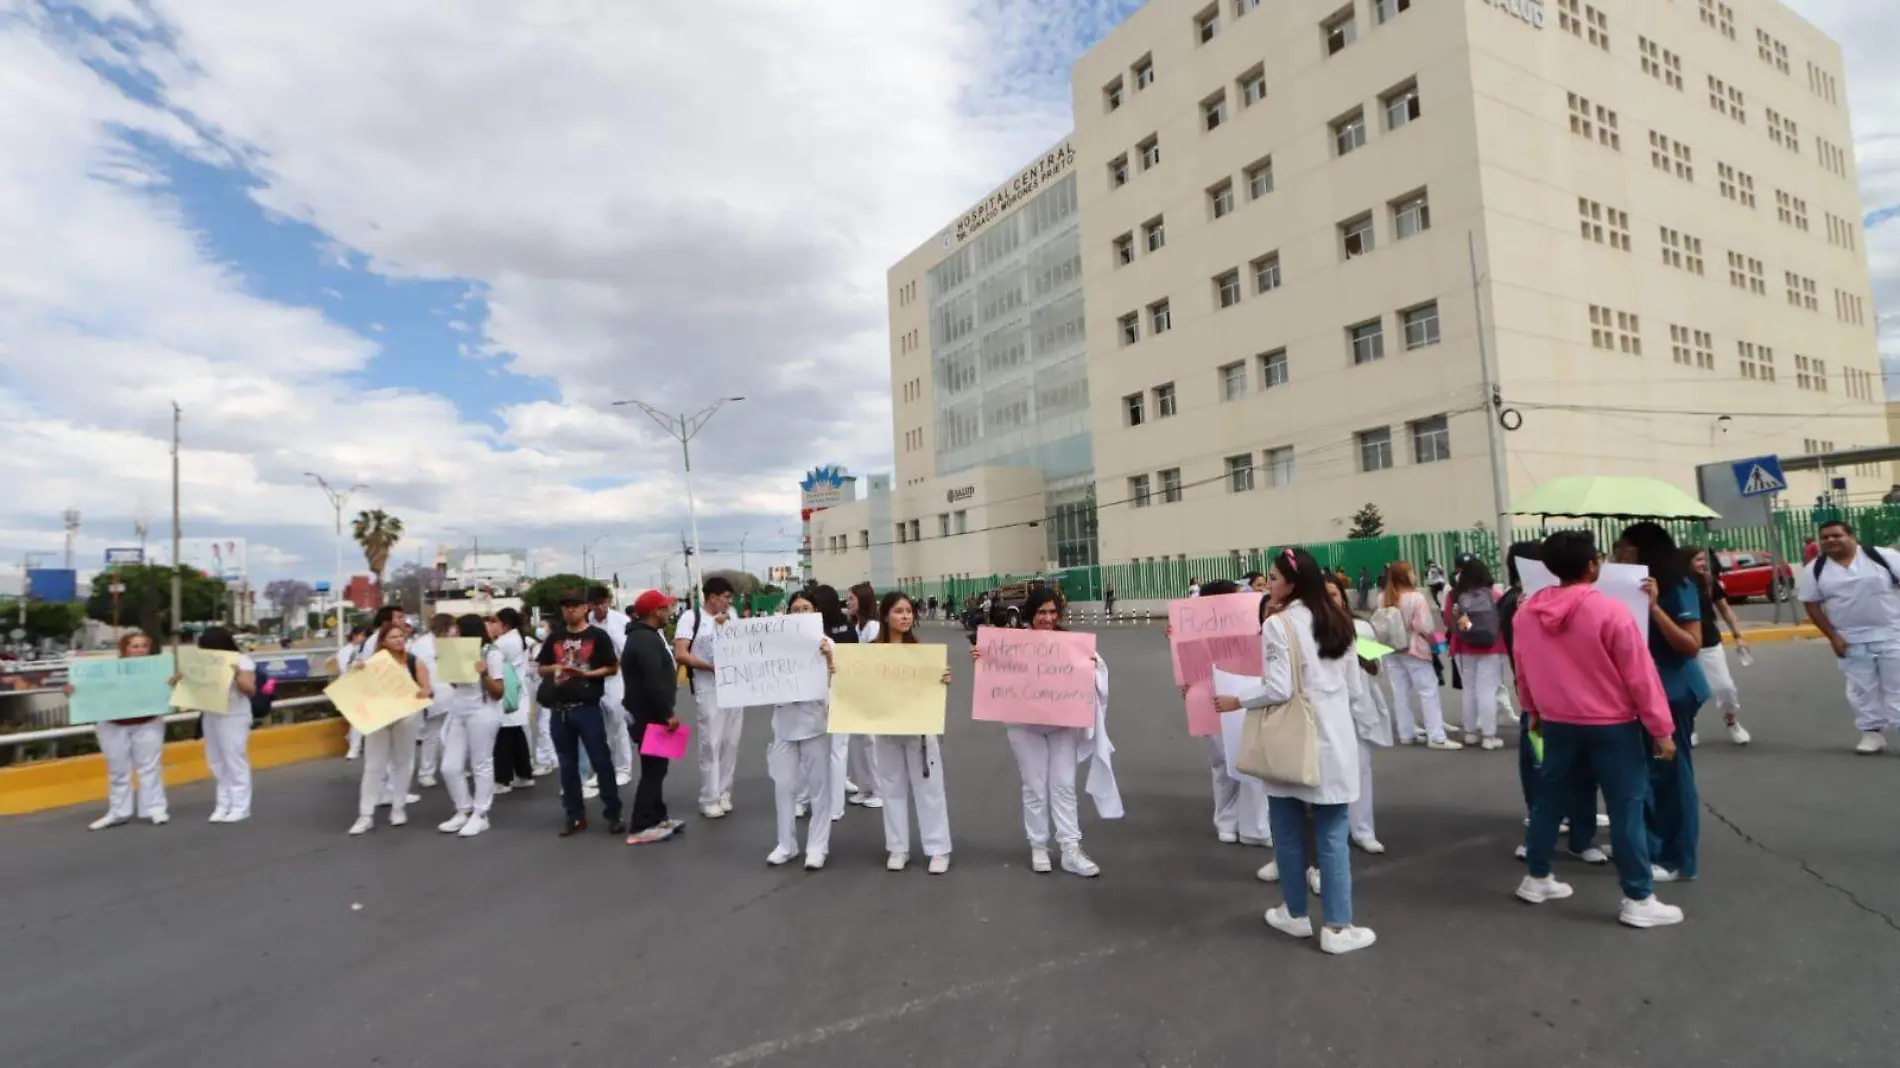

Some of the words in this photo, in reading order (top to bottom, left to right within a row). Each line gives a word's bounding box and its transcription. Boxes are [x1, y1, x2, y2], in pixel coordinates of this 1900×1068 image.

[1483, 0, 1544, 30] LUD
[956, 187, 1010, 232] HOSPITAL
[1013, 141, 1074, 190] CENTRAL
